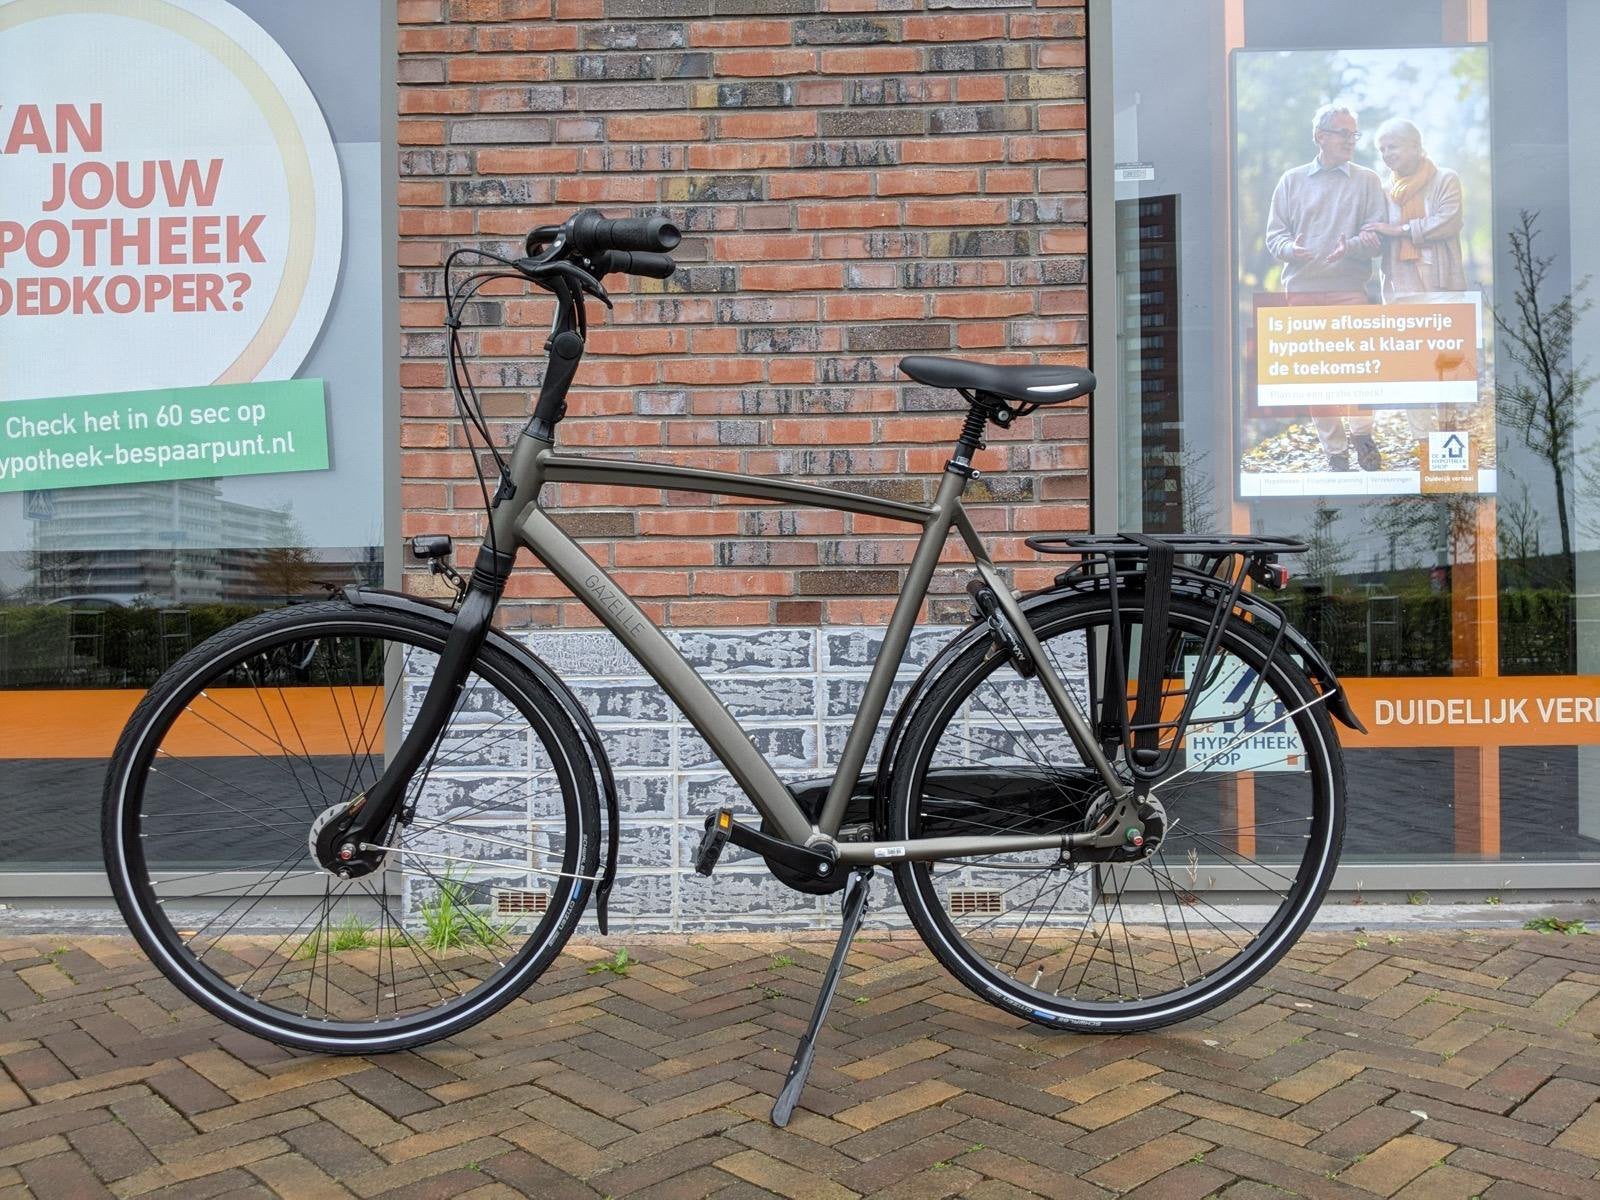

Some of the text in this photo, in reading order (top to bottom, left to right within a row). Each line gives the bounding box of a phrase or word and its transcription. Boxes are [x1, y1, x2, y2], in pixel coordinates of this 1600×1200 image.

[0, 102, 103, 154] AN
[42, 158, 224, 212] JOUW
[1268, 313, 1452, 335] Is jouw aflossingsvrije
[1268, 336, 1465, 357] hypotheek al klaar voor
[1268, 359, 1381, 376] de toekomst?
[6, 403, 266, 438] Check het in 60 sec op
[585, 574, 646, 638] GAZELLE
[1375, 697, 1600, 725] DUIDELIJK VER
[1193, 736, 1298, 749] HYPOTHEEK
